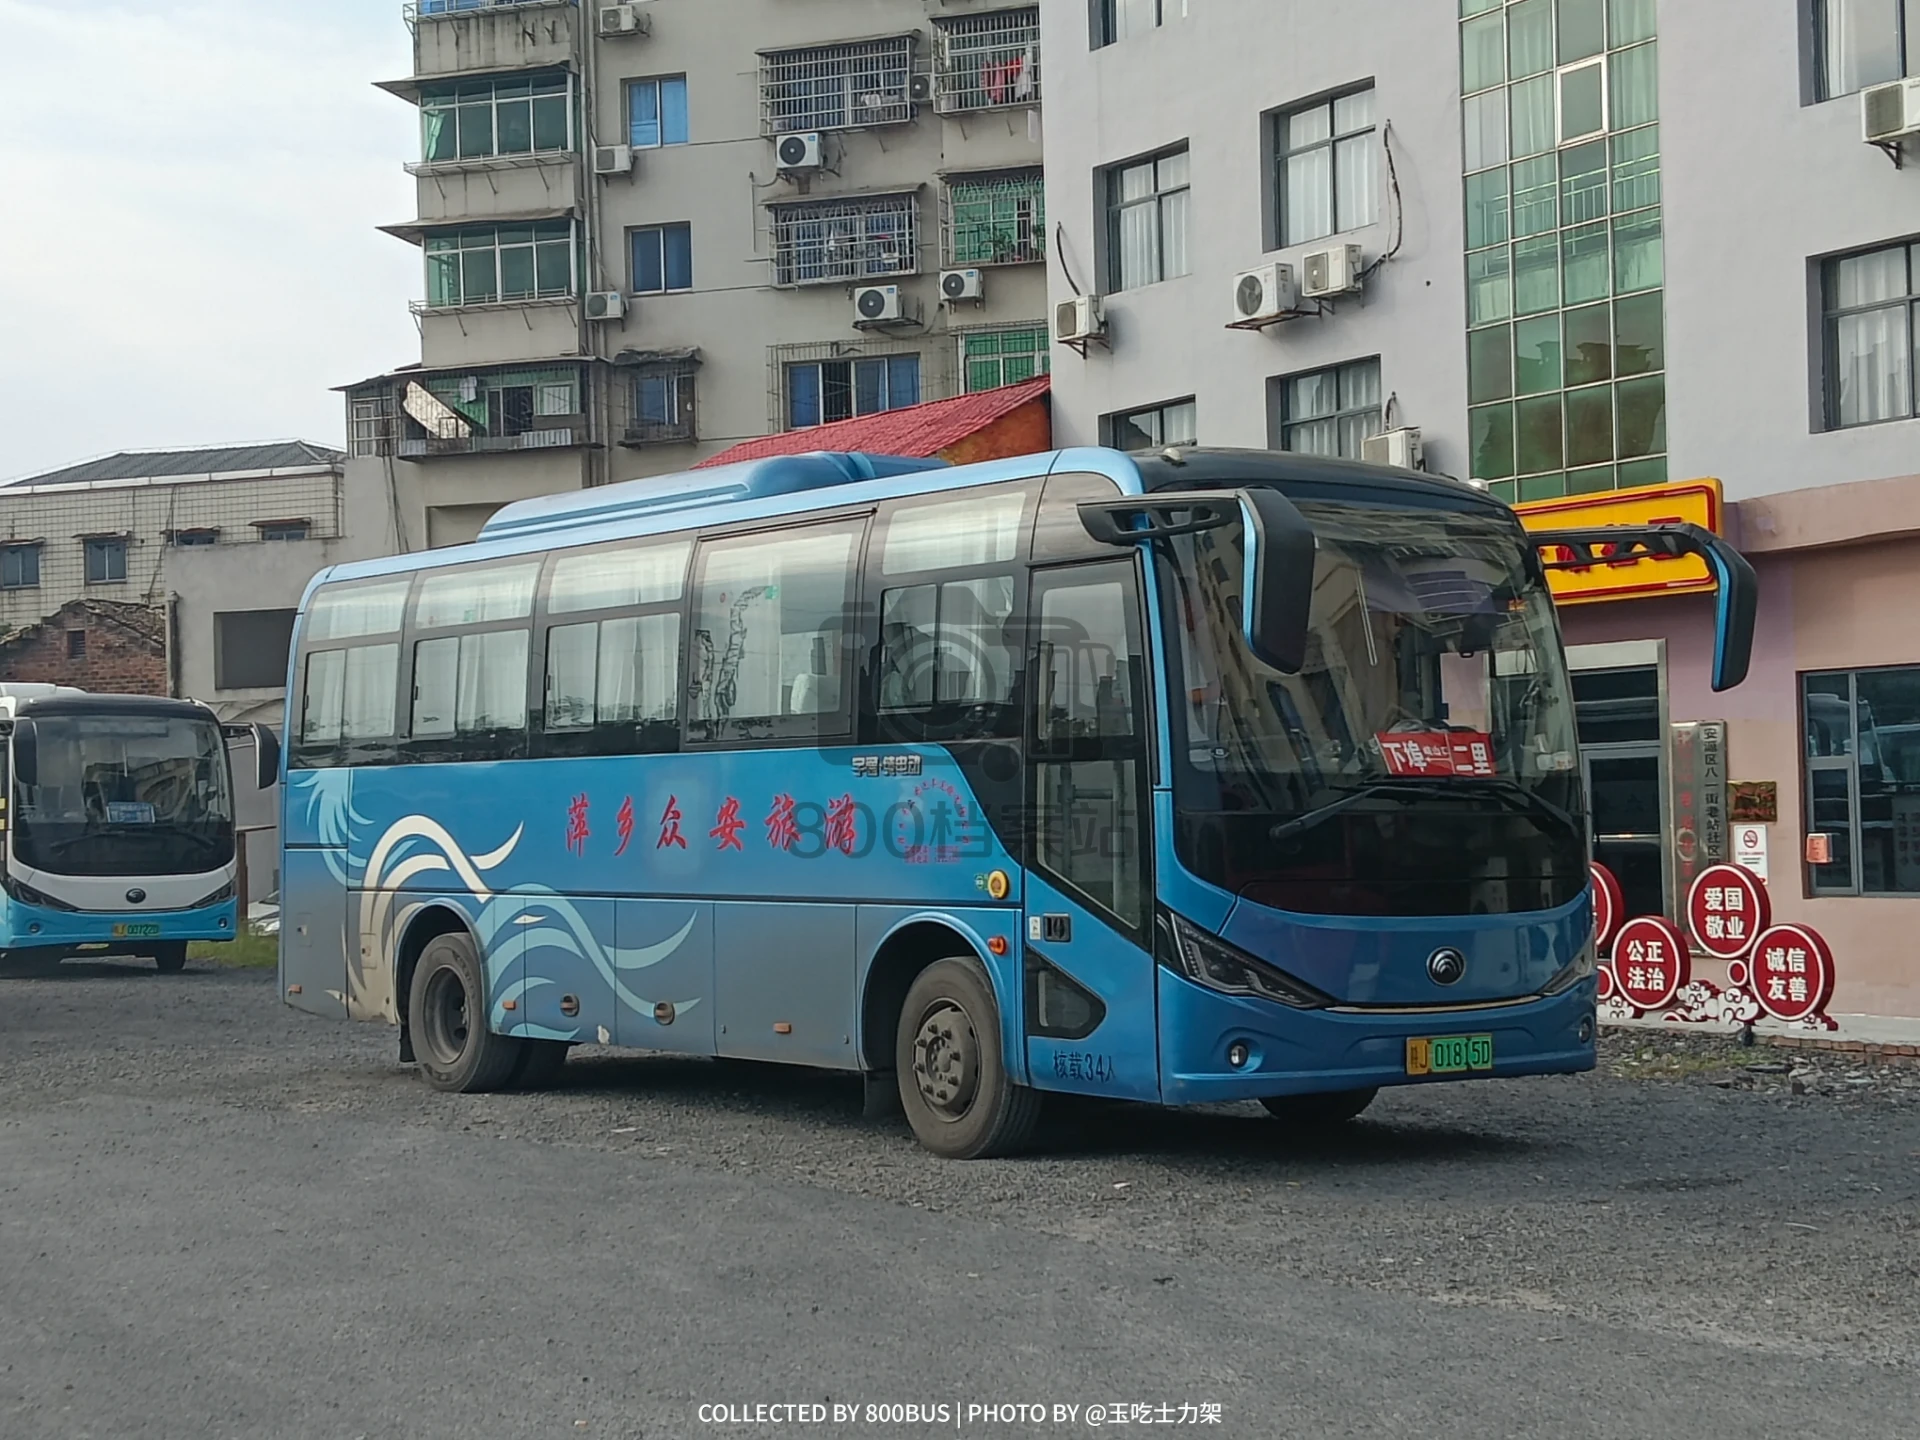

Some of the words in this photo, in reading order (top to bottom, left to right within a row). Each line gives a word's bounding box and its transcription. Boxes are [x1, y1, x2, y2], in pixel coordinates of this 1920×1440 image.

[565, 793, 856, 856] 萍乡众安旅游
[1704, 887, 1744, 912] 爱国
[1704, 915, 1746, 941] 敬业
[1626, 939, 1665, 963] 公正
[1765, 947, 1807, 974] 诚信
[1627, 966, 1665, 991] 法治
[1767, 976, 1809, 1002] 友善
[1053, 1051, 1116, 1082] 核载34人
